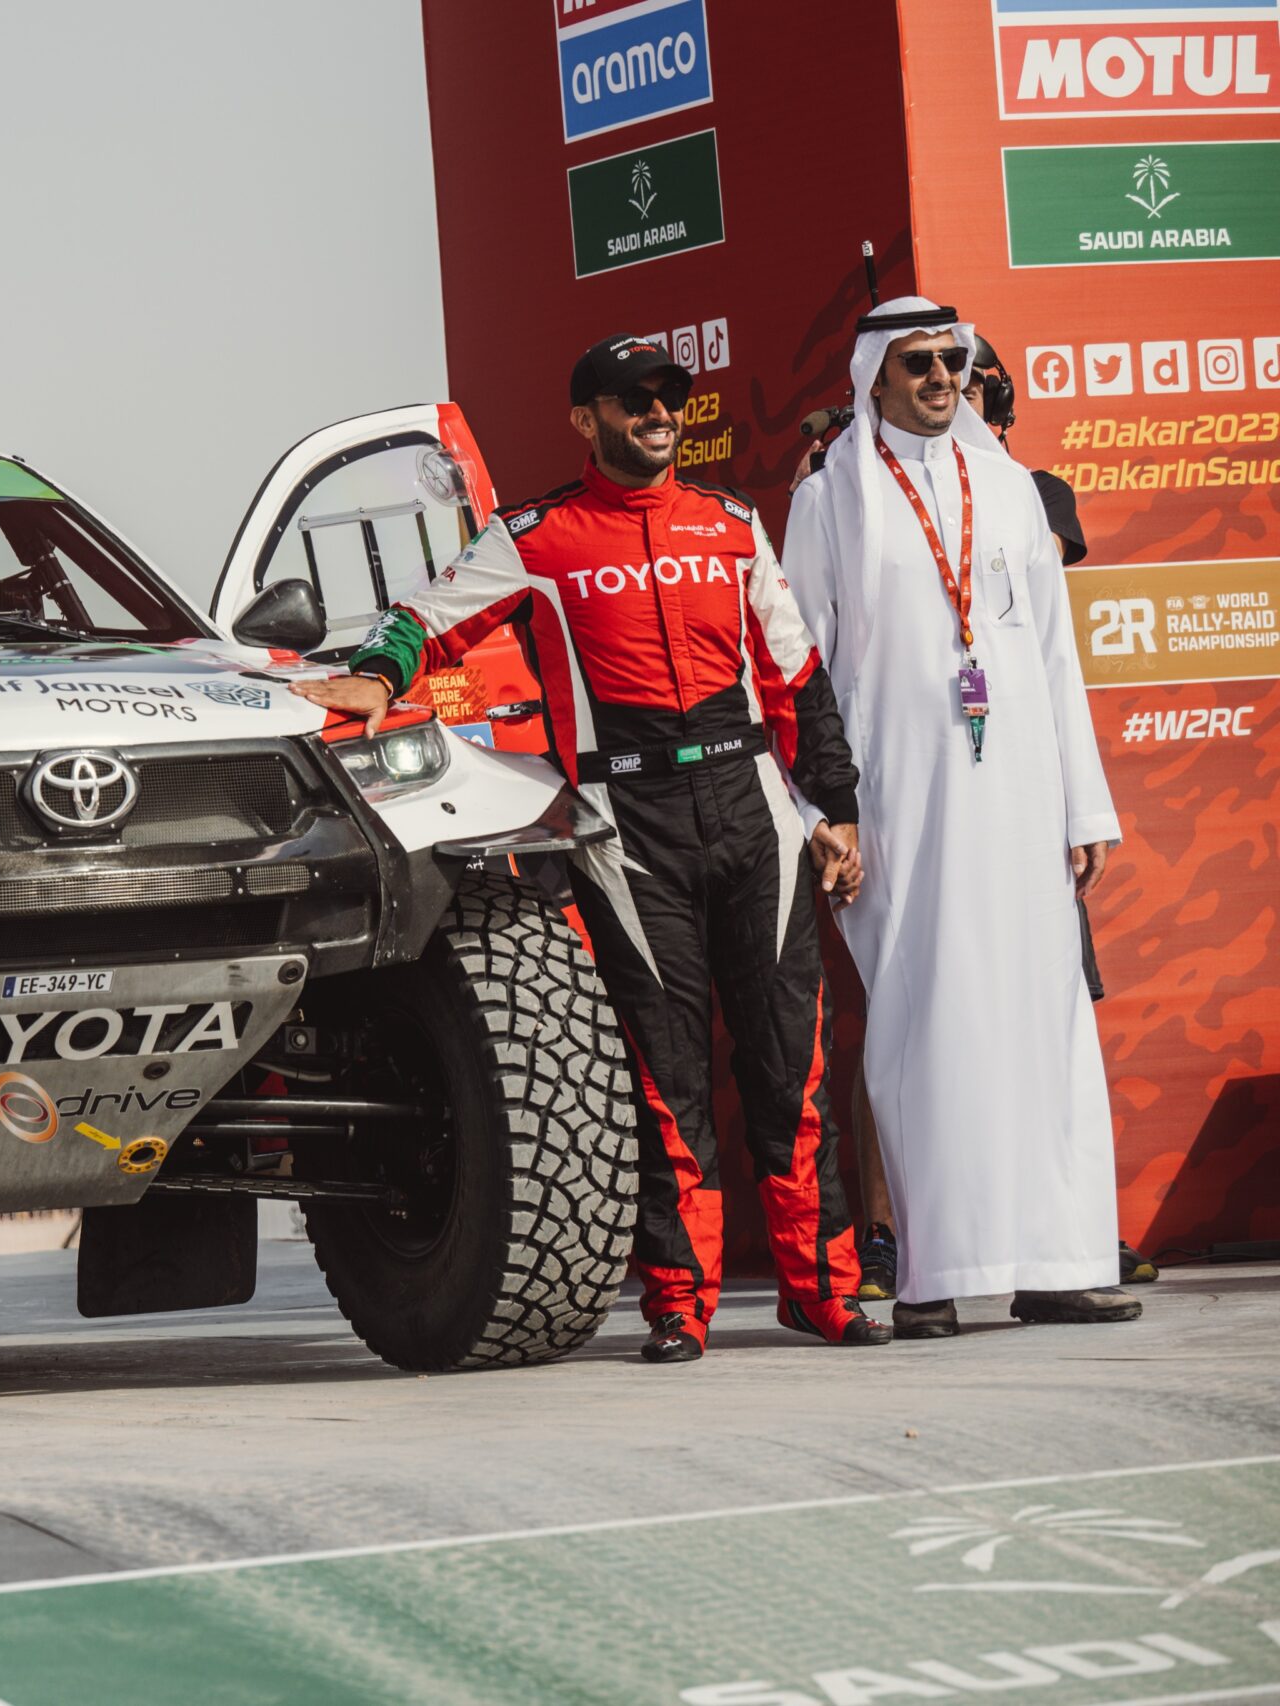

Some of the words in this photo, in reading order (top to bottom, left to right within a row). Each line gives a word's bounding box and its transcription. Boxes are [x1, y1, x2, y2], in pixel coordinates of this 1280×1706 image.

[572, 32, 696, 104] aramco
[1017, 35, 1271, 100] MOTUL
[607, 232, 641, 256] SAUDI
[644, 221, 687, 247] ARABIA
[1079, 231, 1144, 251] SAUDI
[1150, 228, 1232, 248] ARABIA
[1061, 412, 1280, 450] #Dakar2023
[1047, 457, 1280, 493] #DakarInSau
[510, 511, 538, 531] OMP
[568, 555, 731, 599] TOYOTA
[1216, 592, 1269, 609] WORLD
[1166, 610, 1276, 633] RALLY-RAID
[1168, 632, 1280, 652] CHAMPIONSHIP
[34, 679, 185, 699] Jameel
[429, 674, 470, 691] DREAM.
[432, 690, 464, 704] DARE.
[56, 698, 198, 722] MOTORS
[436, 704, 459, 719] LIVE
[460, 702, 474, 716] IT.
[1122, 706, 1255, 743] #W2RC
[611, 757, 642, 772] OMP
[19, 973, 107, 995] EE-349-YC
[55, 1084, 202, 1119] drive
